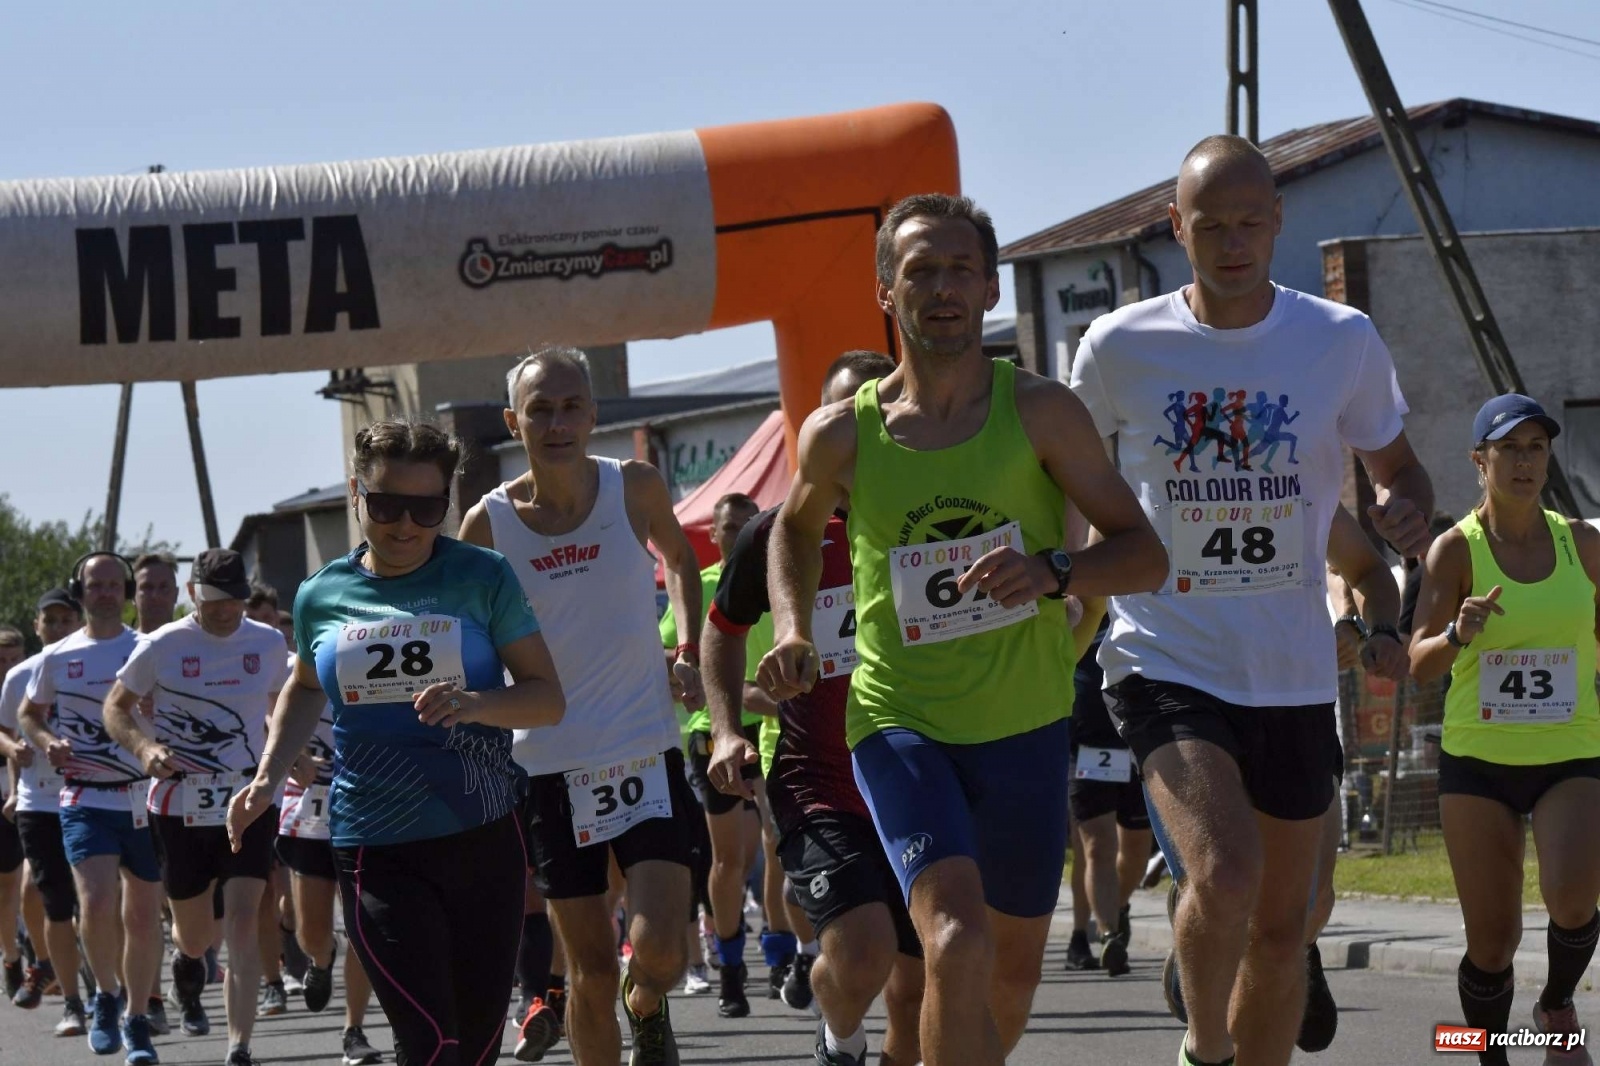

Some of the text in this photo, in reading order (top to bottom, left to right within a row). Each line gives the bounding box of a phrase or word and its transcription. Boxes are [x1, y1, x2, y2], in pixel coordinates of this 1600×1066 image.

[498, 224, 660, 247] Elektroniczny pomiar czasu
[76, 214, 381, 345] META
[1165, 473, 1301, 502] COLOUR RUN
[1181, 502, 1294, 523] COLOUR RUN
[901, 530, 1012, 568] COLOUR RUN
[1201, 526, 1276, 565] 48
[529, 543, 601, 573] RAFAKO
[549, 565, 590, 580] GRUPA PBG
[1177, 562, 1299, 578] 10km, Krzanowice, 05.09.2021
[815, 590, 856, 610] COLO
[932, 606, 984, 621] Krzanowice,
[346, 619, 452, 642] COLOUR RUN
[365, 639, 434, 680] 28
[1486, 653, 1569, 667] COLOUR RUN
[1499, 669, 1554, 700] 43
[1098, 751, 1111, 768] 2
[573, 756, 657, 787] COLOUR RUN
[197, 786, 233, 809] 37
[591, 776, 644, 817] 30
